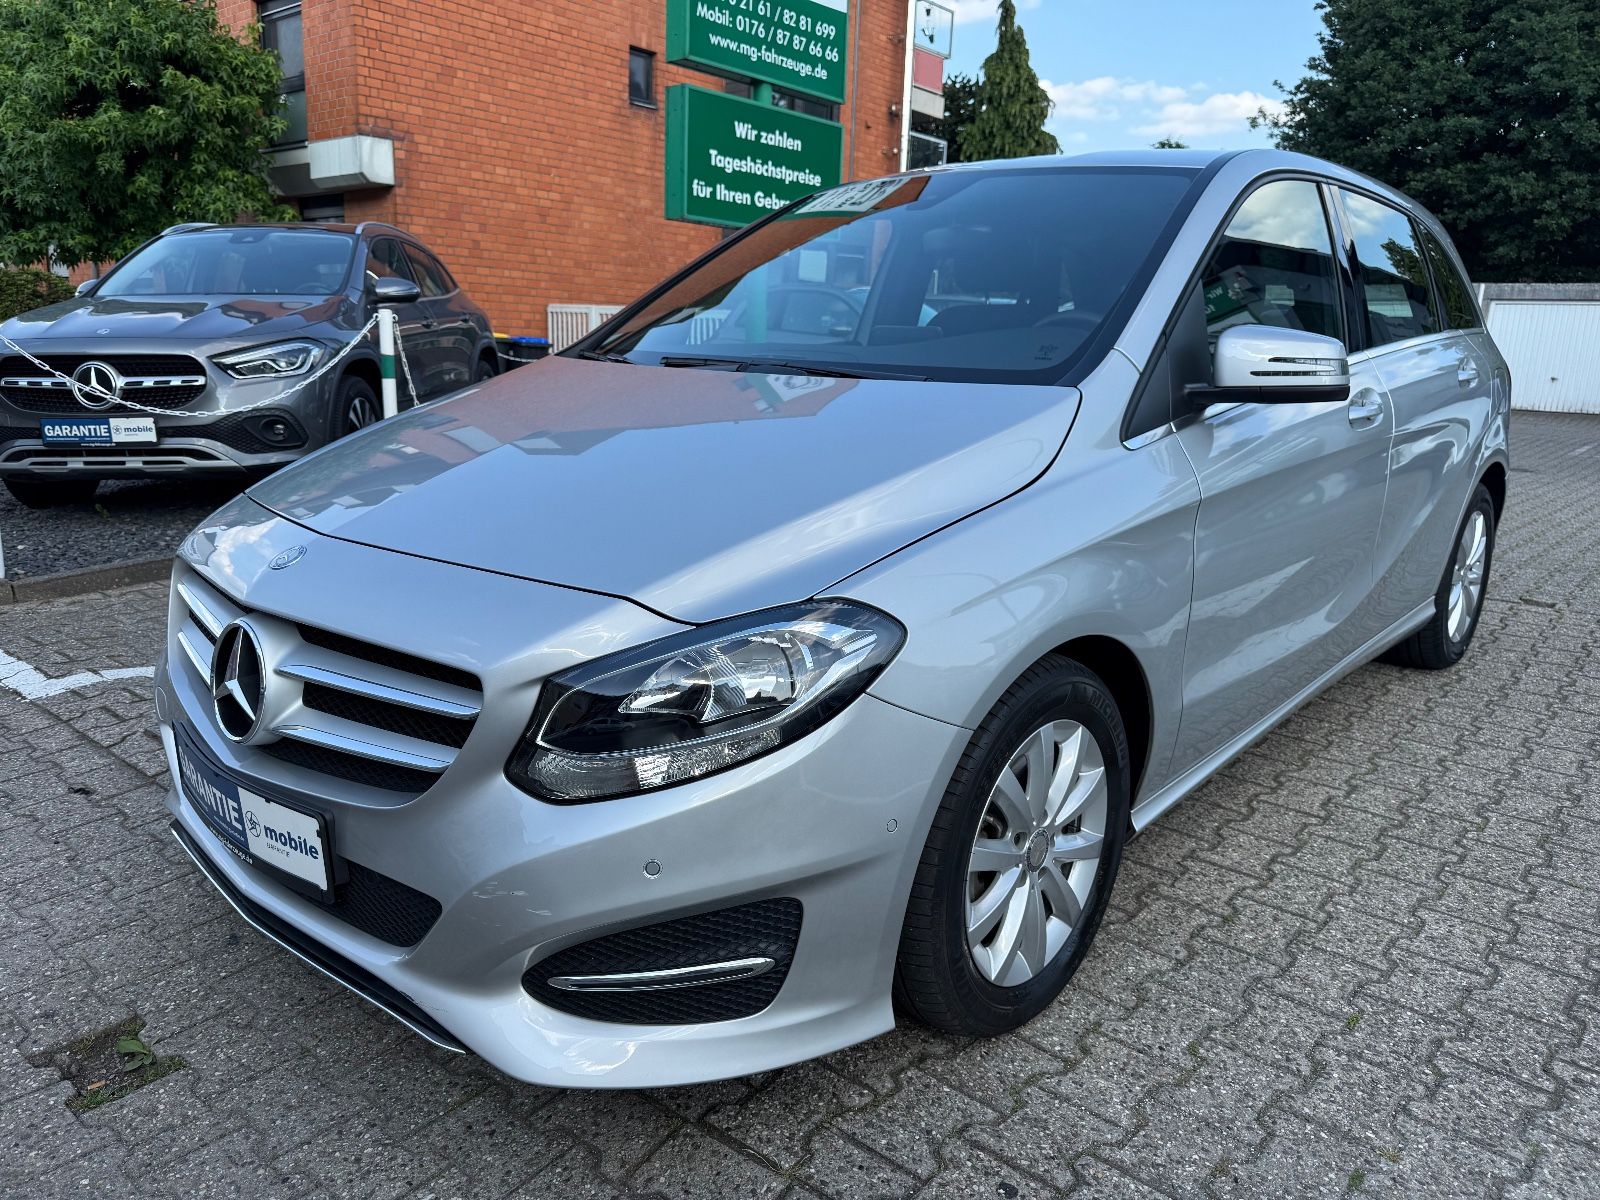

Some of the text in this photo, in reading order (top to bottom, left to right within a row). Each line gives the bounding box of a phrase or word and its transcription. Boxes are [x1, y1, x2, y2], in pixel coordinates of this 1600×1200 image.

[696, 1, 839, 62] Mobil: 0176 / 87 87 66 66
[757, 0, 771, 17] 61
[774, 6, 781, 22] /
[783, 9, 796, 27] 82
[799, 14, 812, 32] 81
[816, 21, 836, 40] 699
[709, 32, 828, 80] www.mg-fahrzeuge.de
[734, 120, 802, 152] Wir zahlen
[709, 149, 822, 187] Tageshöchstpreise
[692, 179, 713, 199] für
[716, 183, 751, 206] Ihren
[44, 425, 153, 437] GARANTIE mobile
[178, 745, 243, 830] GARANTIE
[263, 824, 319, 860] mobile
